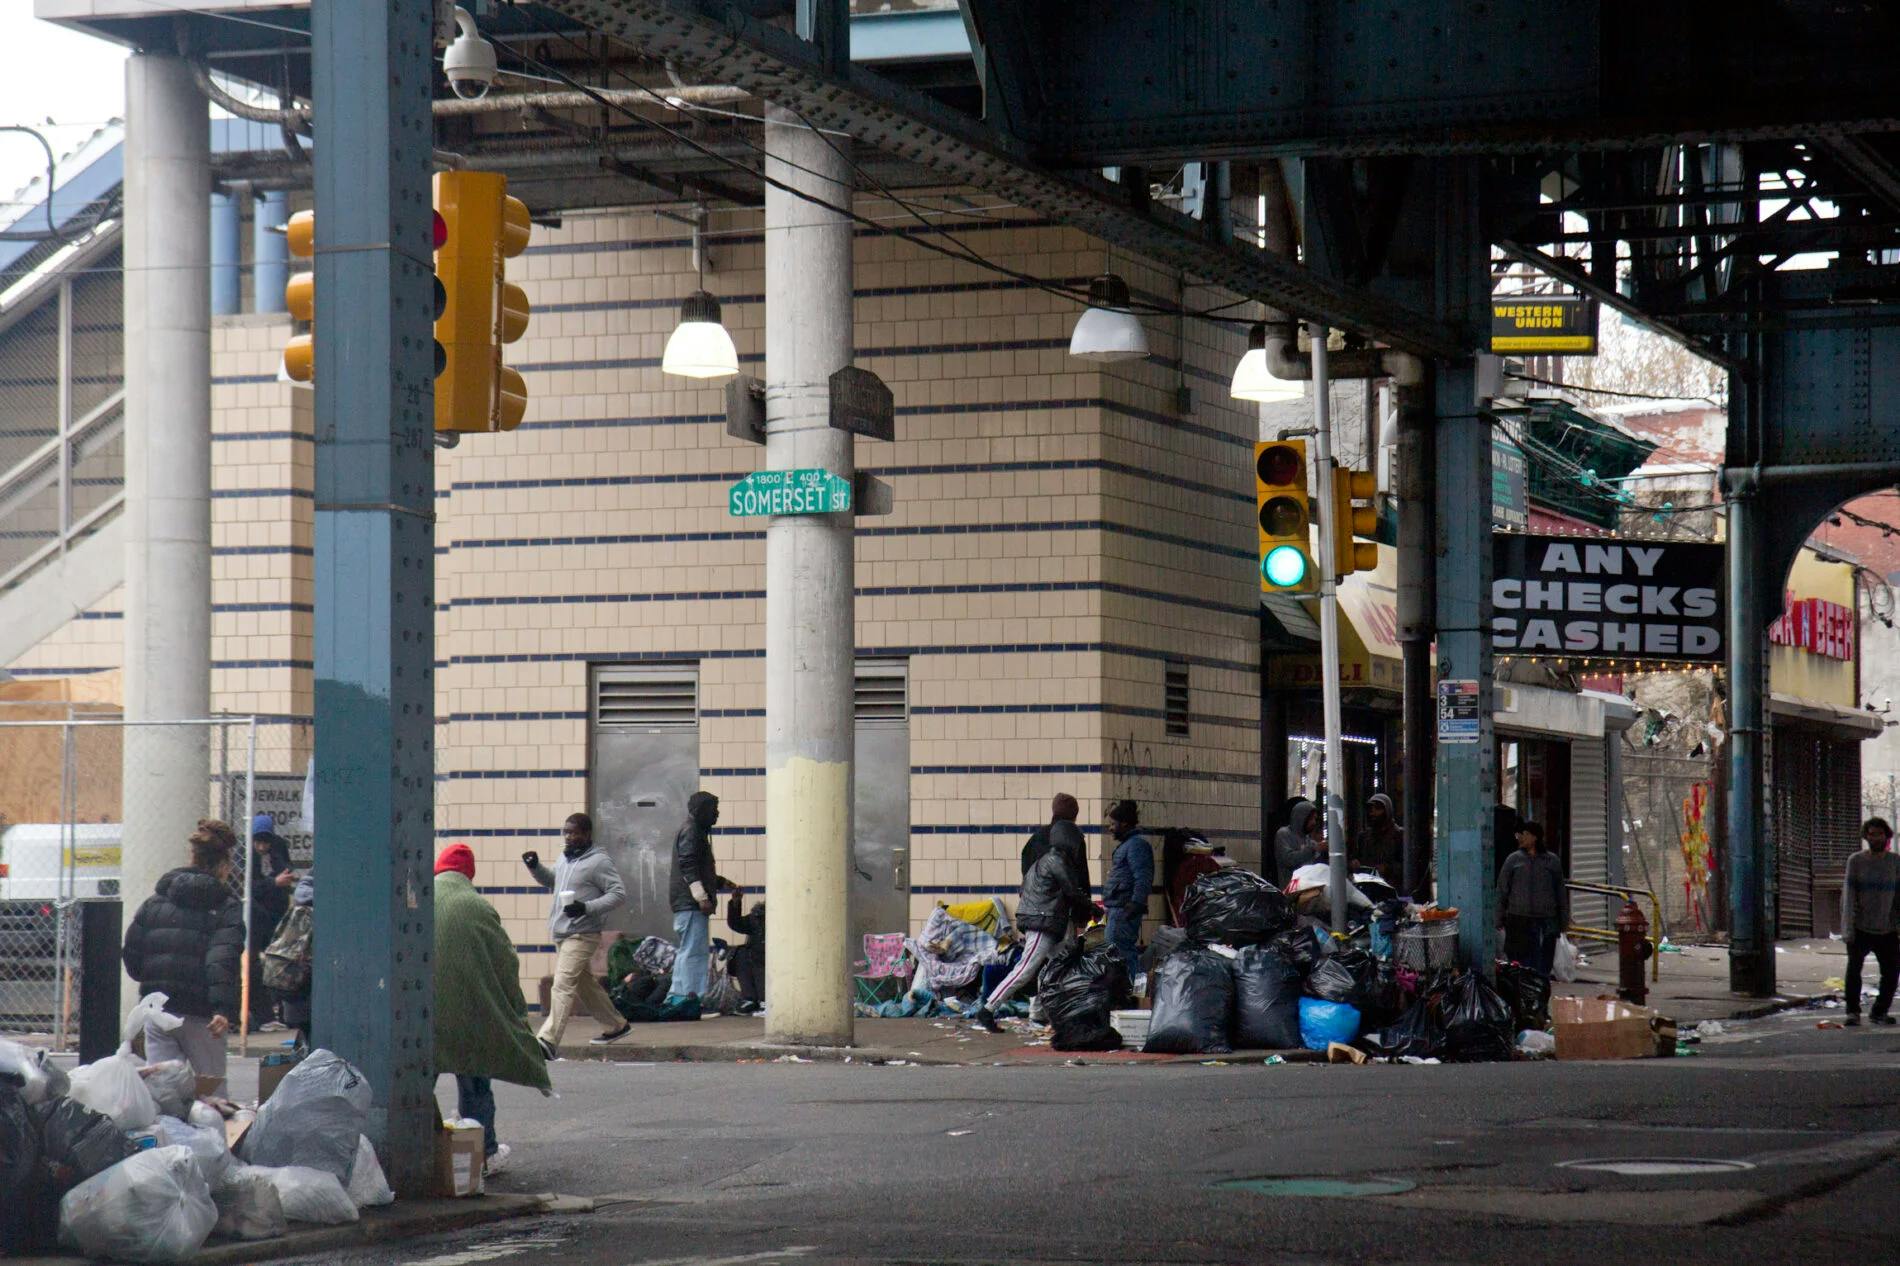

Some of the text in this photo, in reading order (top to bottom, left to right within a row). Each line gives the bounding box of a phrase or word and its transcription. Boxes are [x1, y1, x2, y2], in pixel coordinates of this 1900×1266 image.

[1494, 305, 1563, 318] WESTERN
[1515, 317, 1563, 328] UNION
[756, 471, 820, 484] 1800 E 400
[733, 487, 826, 515] SOMERSET
[1540, 542, 1666, 576] ANY
[1492, 578, 1718, 618] CHECKS
[1492, 616, 1721, 655] CASHED
[1295, 663, 1362, 681] DLI
[1440, 695, 1448, 707] 3
[1440, 708, 1455, 720] 54
[239, 790, 300, 802] SDEWALK
